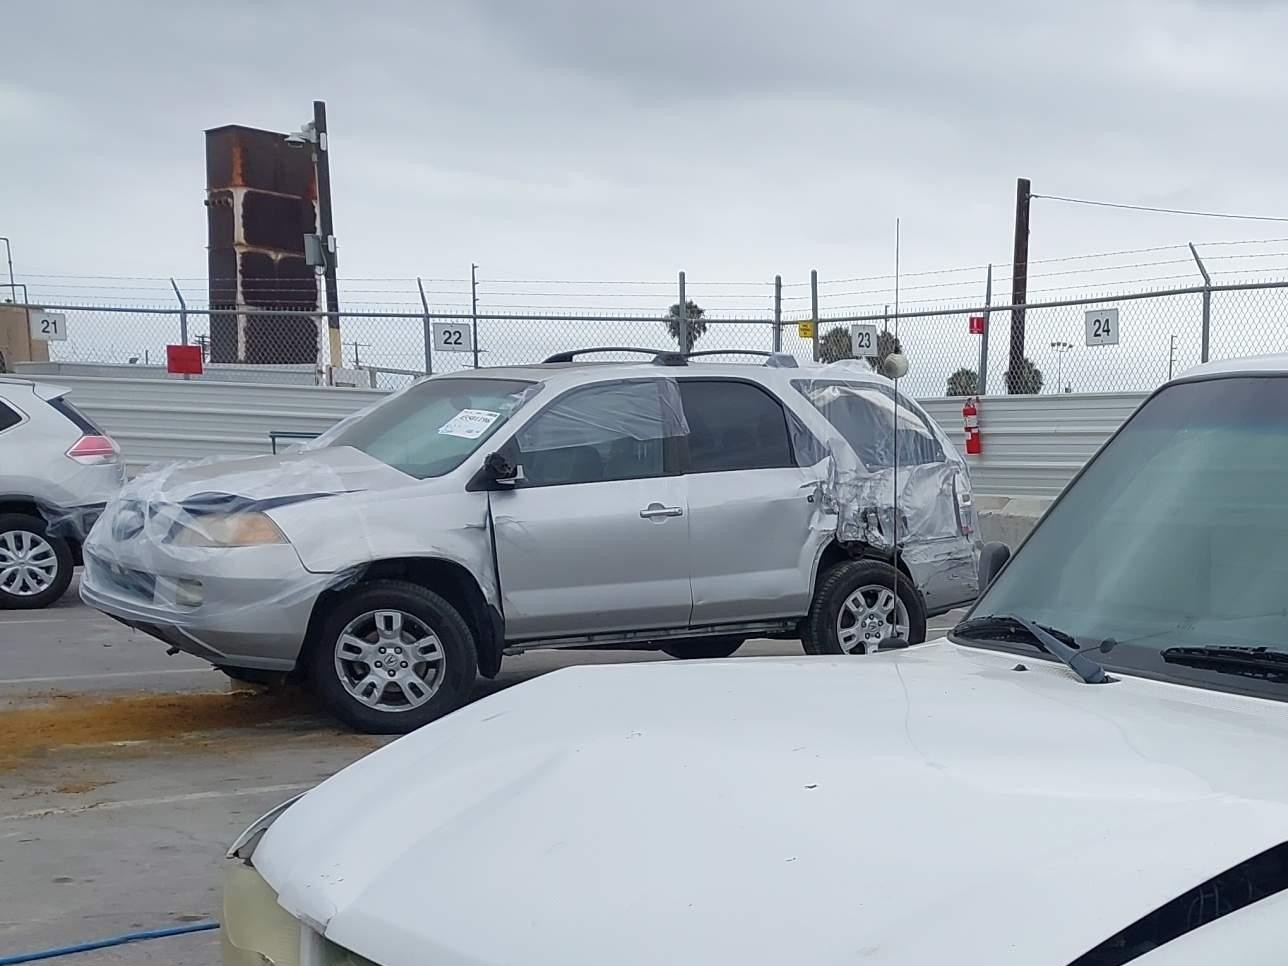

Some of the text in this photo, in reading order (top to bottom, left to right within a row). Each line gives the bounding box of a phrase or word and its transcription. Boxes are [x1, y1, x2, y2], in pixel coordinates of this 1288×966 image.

[40, 319, 58, 334] 21
[1093, 318, 1111, 337] 24
[442, 330, 463, 345] 22
[857, 332, 871, 348] 23
